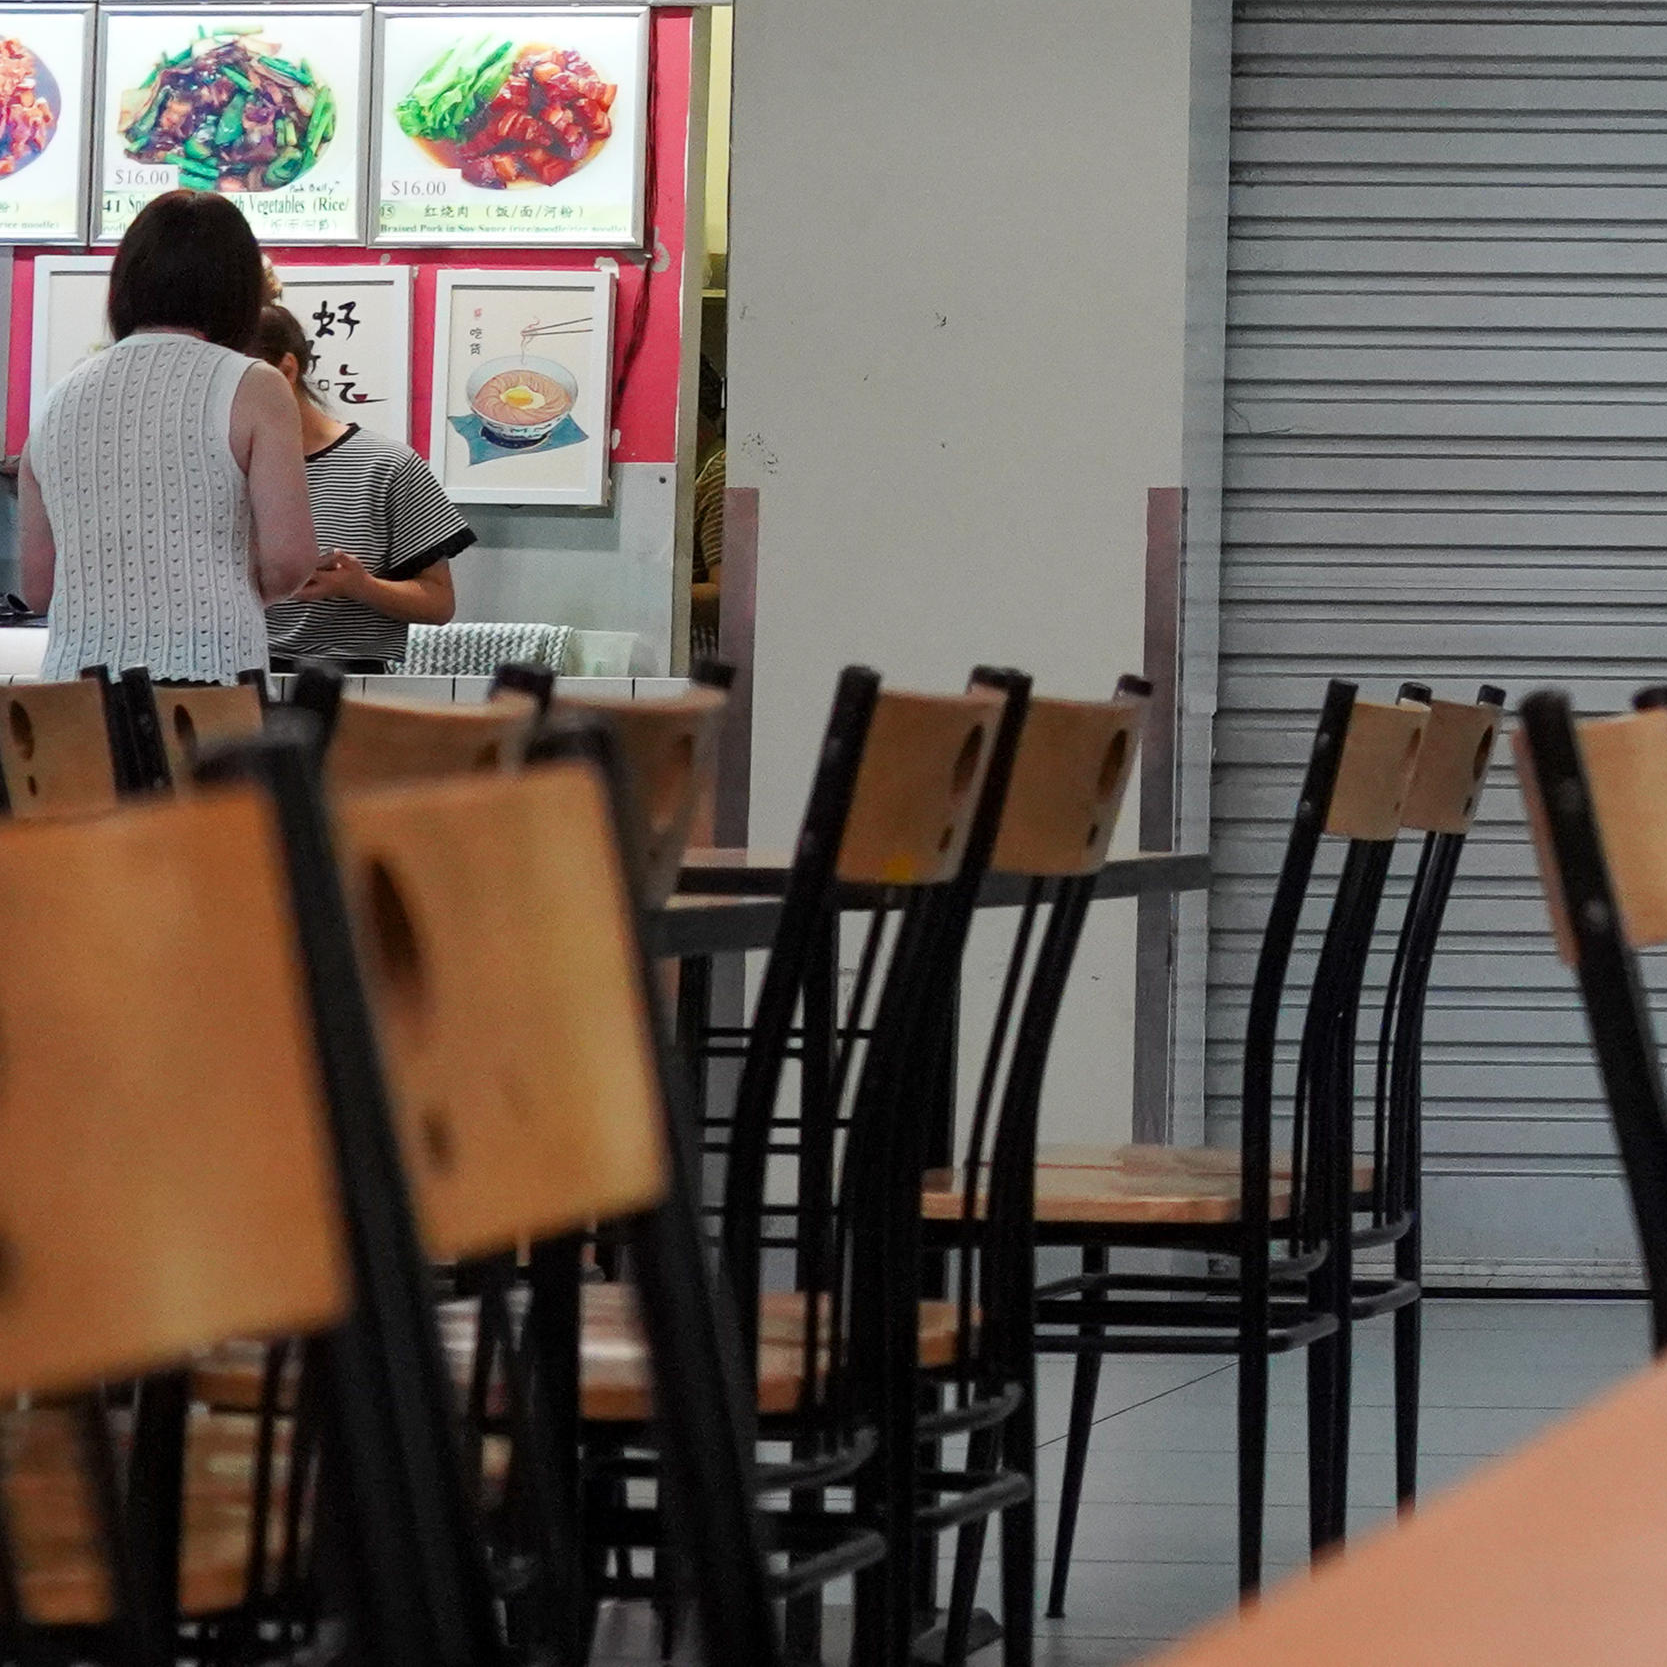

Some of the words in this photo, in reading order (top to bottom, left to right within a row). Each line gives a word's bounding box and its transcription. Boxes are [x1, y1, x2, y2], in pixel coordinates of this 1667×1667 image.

[115, 169, 169, 185] $16.00
[391, 180, 446, 195] $16.00
[249, 194, 305, 215] Vegetables
[423, 204, 469, 218] 红烧肉
[420, 224, 443, 233] Pork
